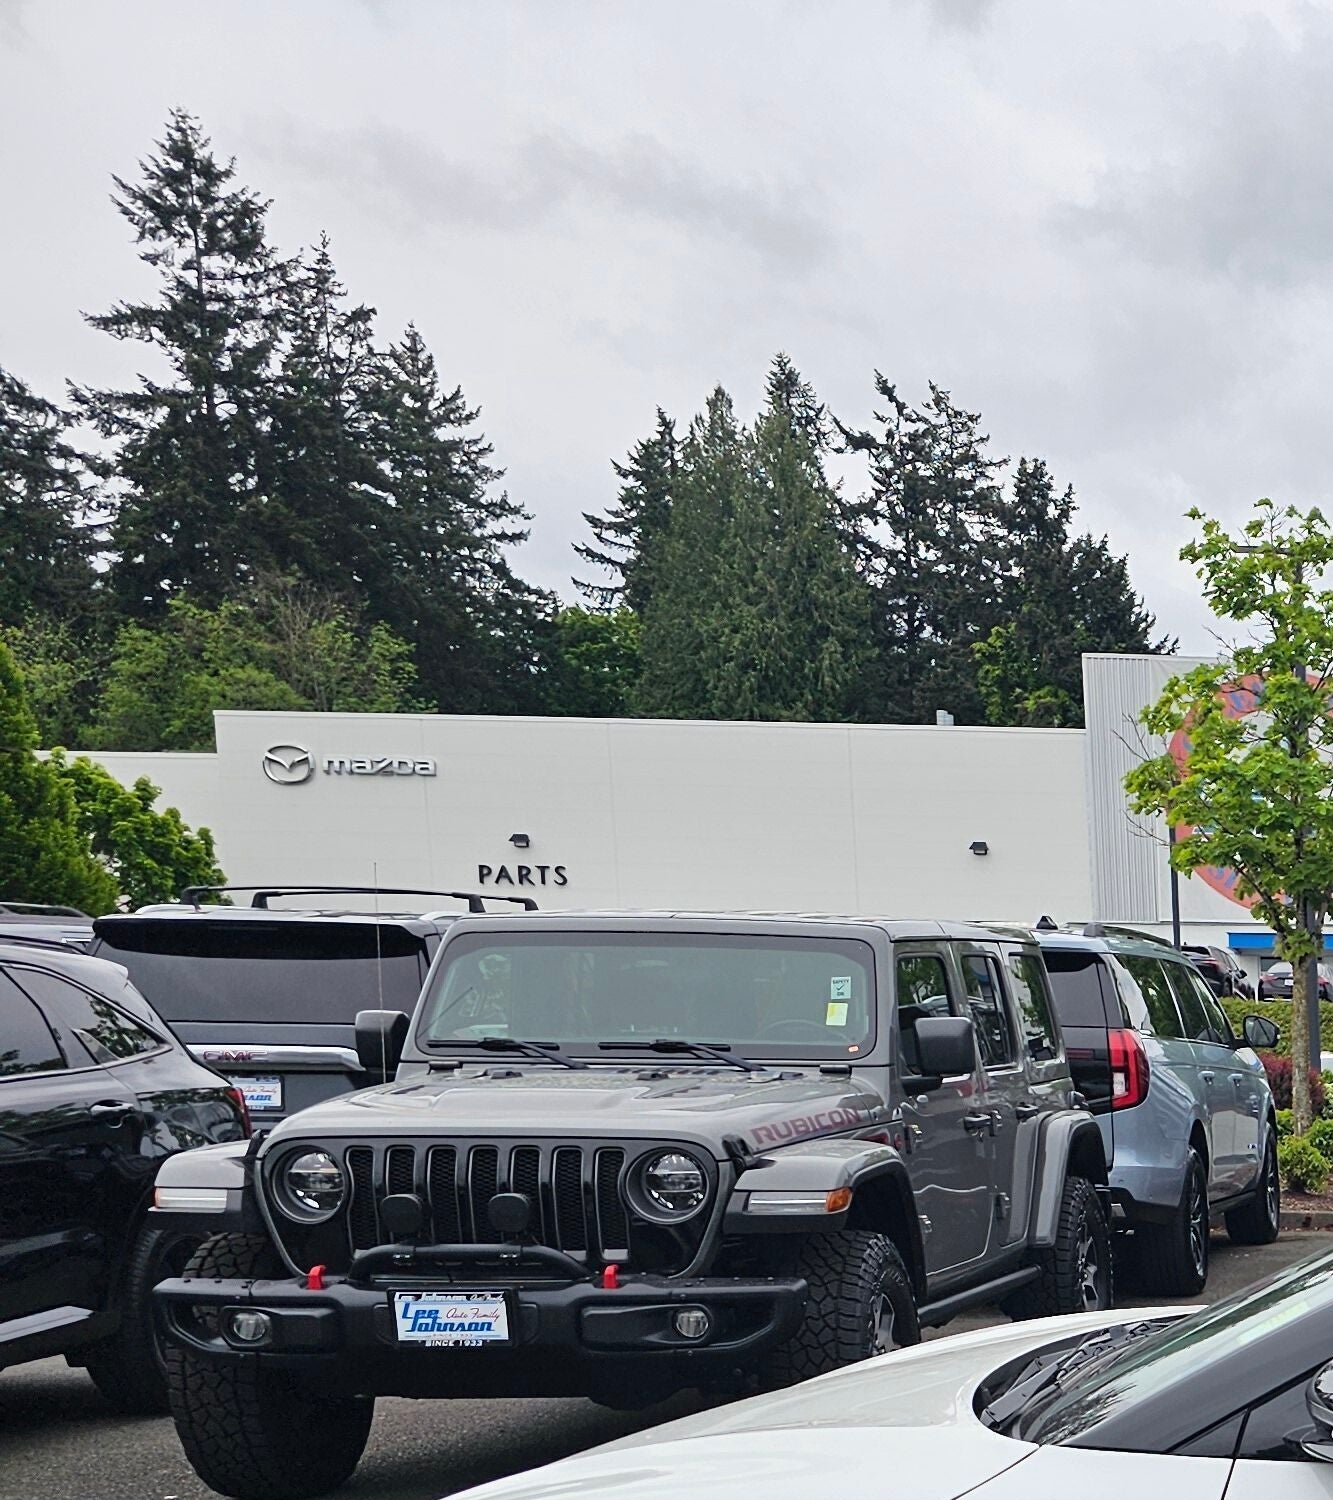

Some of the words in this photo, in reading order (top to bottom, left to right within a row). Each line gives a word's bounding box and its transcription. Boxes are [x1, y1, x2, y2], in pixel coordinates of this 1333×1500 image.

[322, 757, 437, 777] mazda
[478, 864, 569, 886] PARTS
[750, 1108, 861, 1145] RUBICON
[402, 1303, 440, 1319] Lee
[405, 1316, 494, 1332] Johnson
